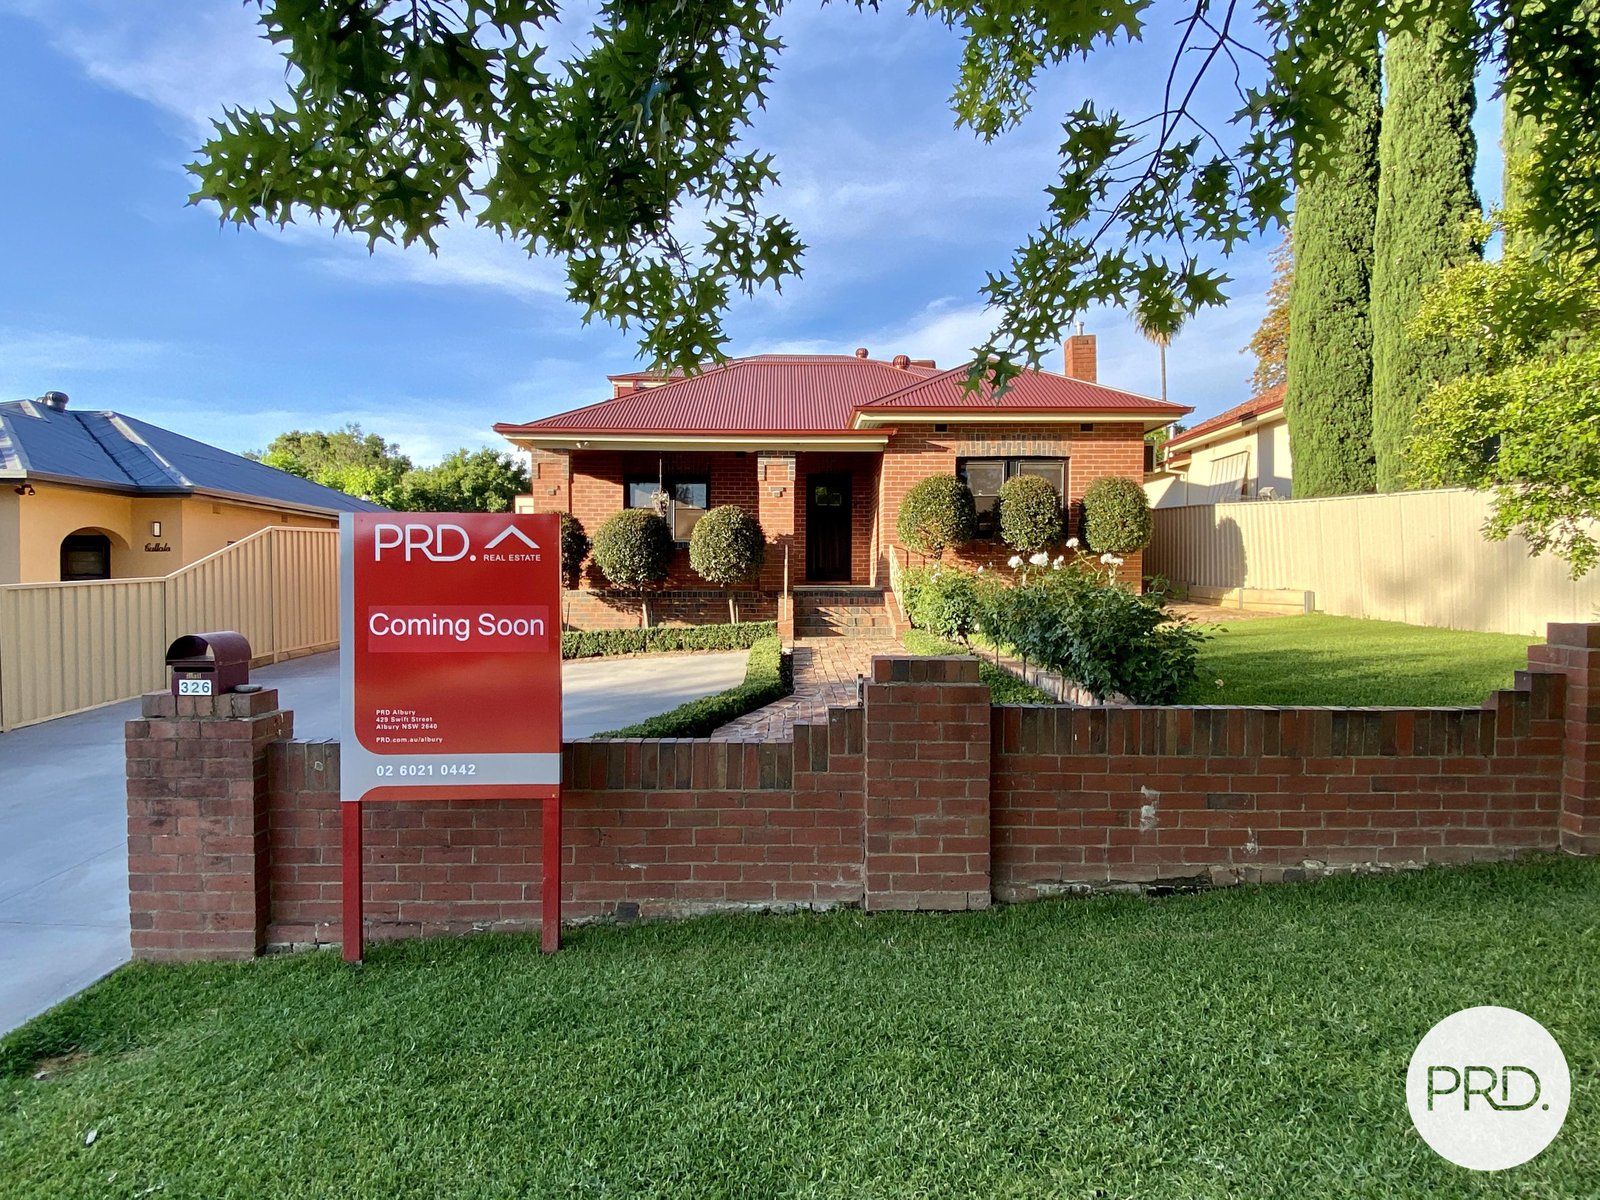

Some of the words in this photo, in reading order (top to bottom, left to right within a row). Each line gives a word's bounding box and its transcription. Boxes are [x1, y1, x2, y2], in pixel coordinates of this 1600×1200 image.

[483, 554, 506, 562] REAL
[508, 554, 541, 562] ESTATE
[369, 612, 470, 642] Coming
[477, 613, 544, 636] Soon
[181, 682, 210, 693] 326
[376, 736, 443, 744] PRD.com.au/albury
[376, 765, 394, 777] 02
[399, 764, 434, 776] 6021
[440, 764, 476, 776] 0442
